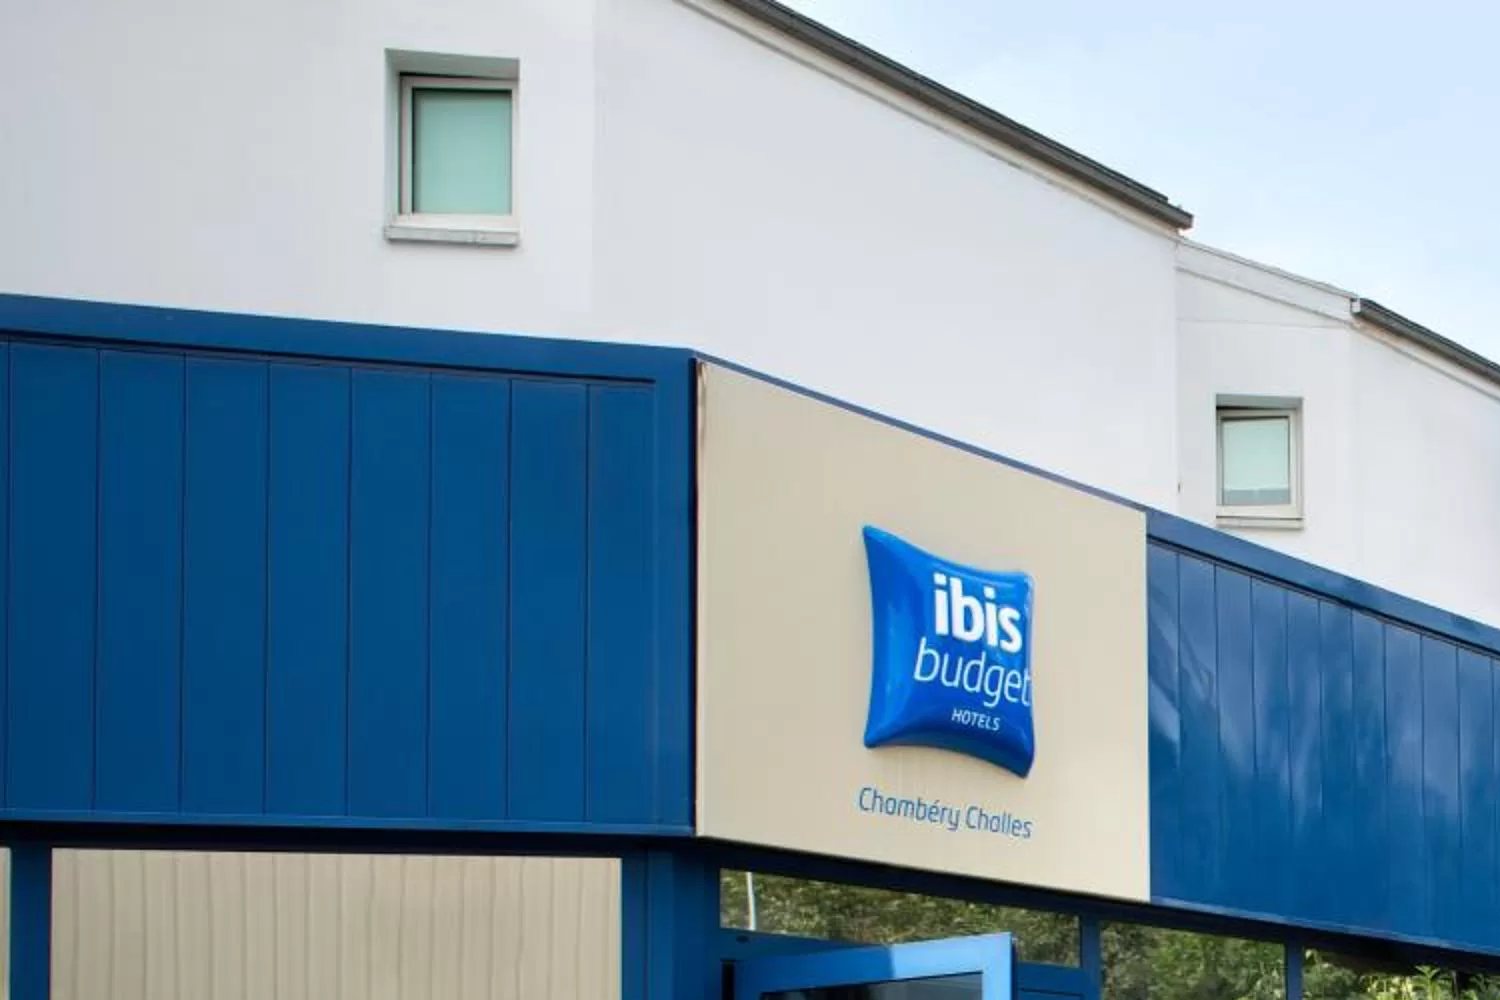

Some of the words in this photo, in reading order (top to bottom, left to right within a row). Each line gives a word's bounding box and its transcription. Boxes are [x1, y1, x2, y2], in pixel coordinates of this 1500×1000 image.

[933, 572, 1023, 654] ibis
[913, 636, 1033, 708] budget
[951, 708, 1001, 731] HOTELS
[859, 787, 960, 831] Chambéry
[965, 805, 1033, 839] Challes
